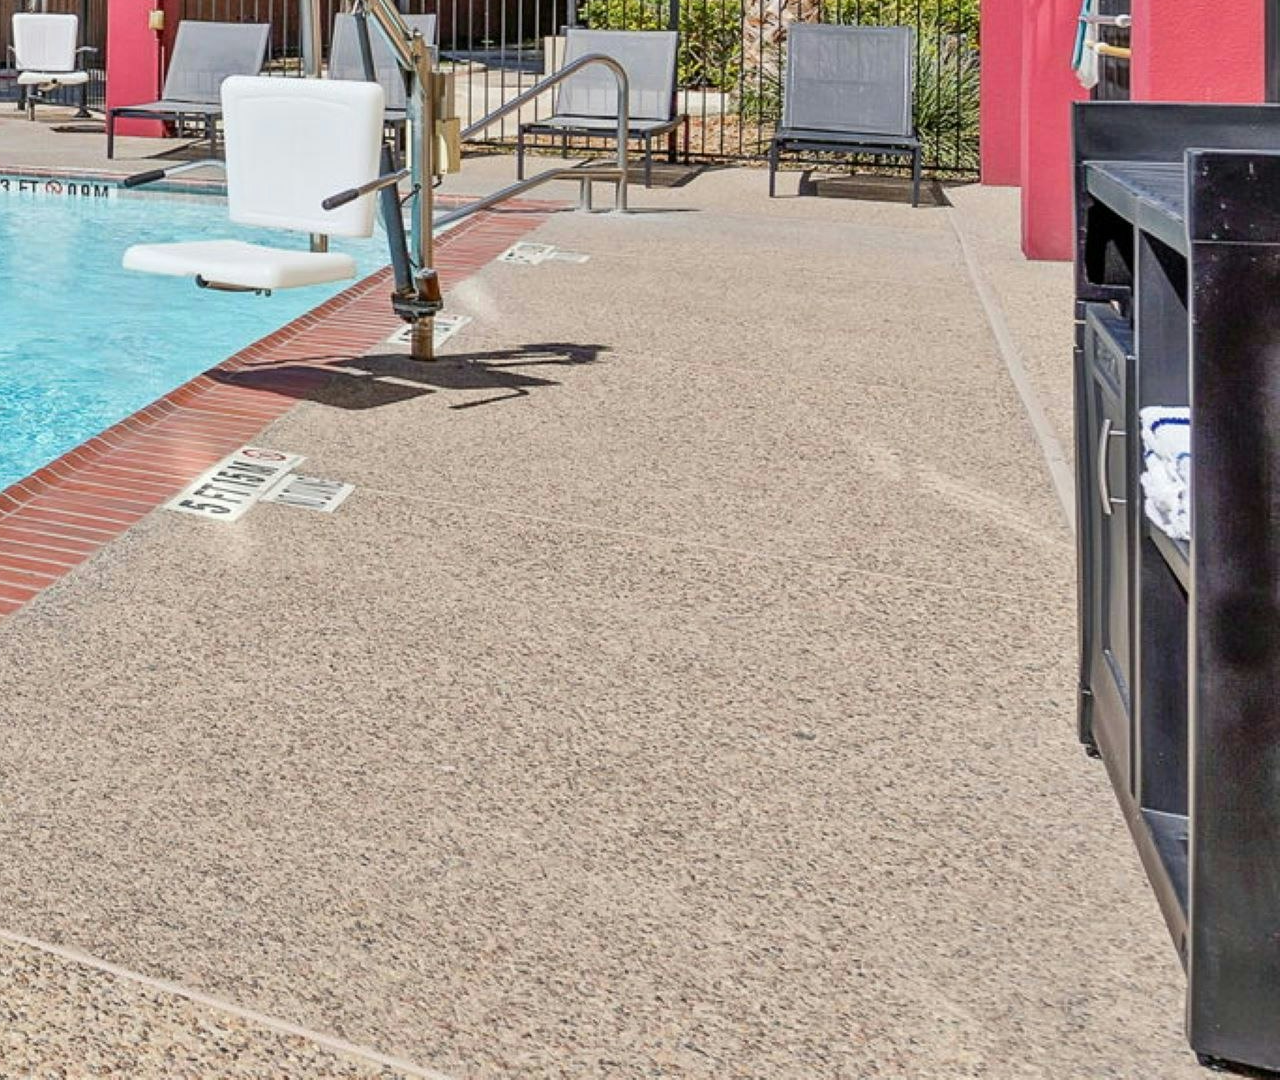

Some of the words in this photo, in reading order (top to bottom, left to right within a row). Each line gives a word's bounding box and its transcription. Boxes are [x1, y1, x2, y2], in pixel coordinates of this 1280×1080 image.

[19, 179, 39, 193] FT
[193, 484, 251, 504] FT
[179, 500, 231, 514] 5
